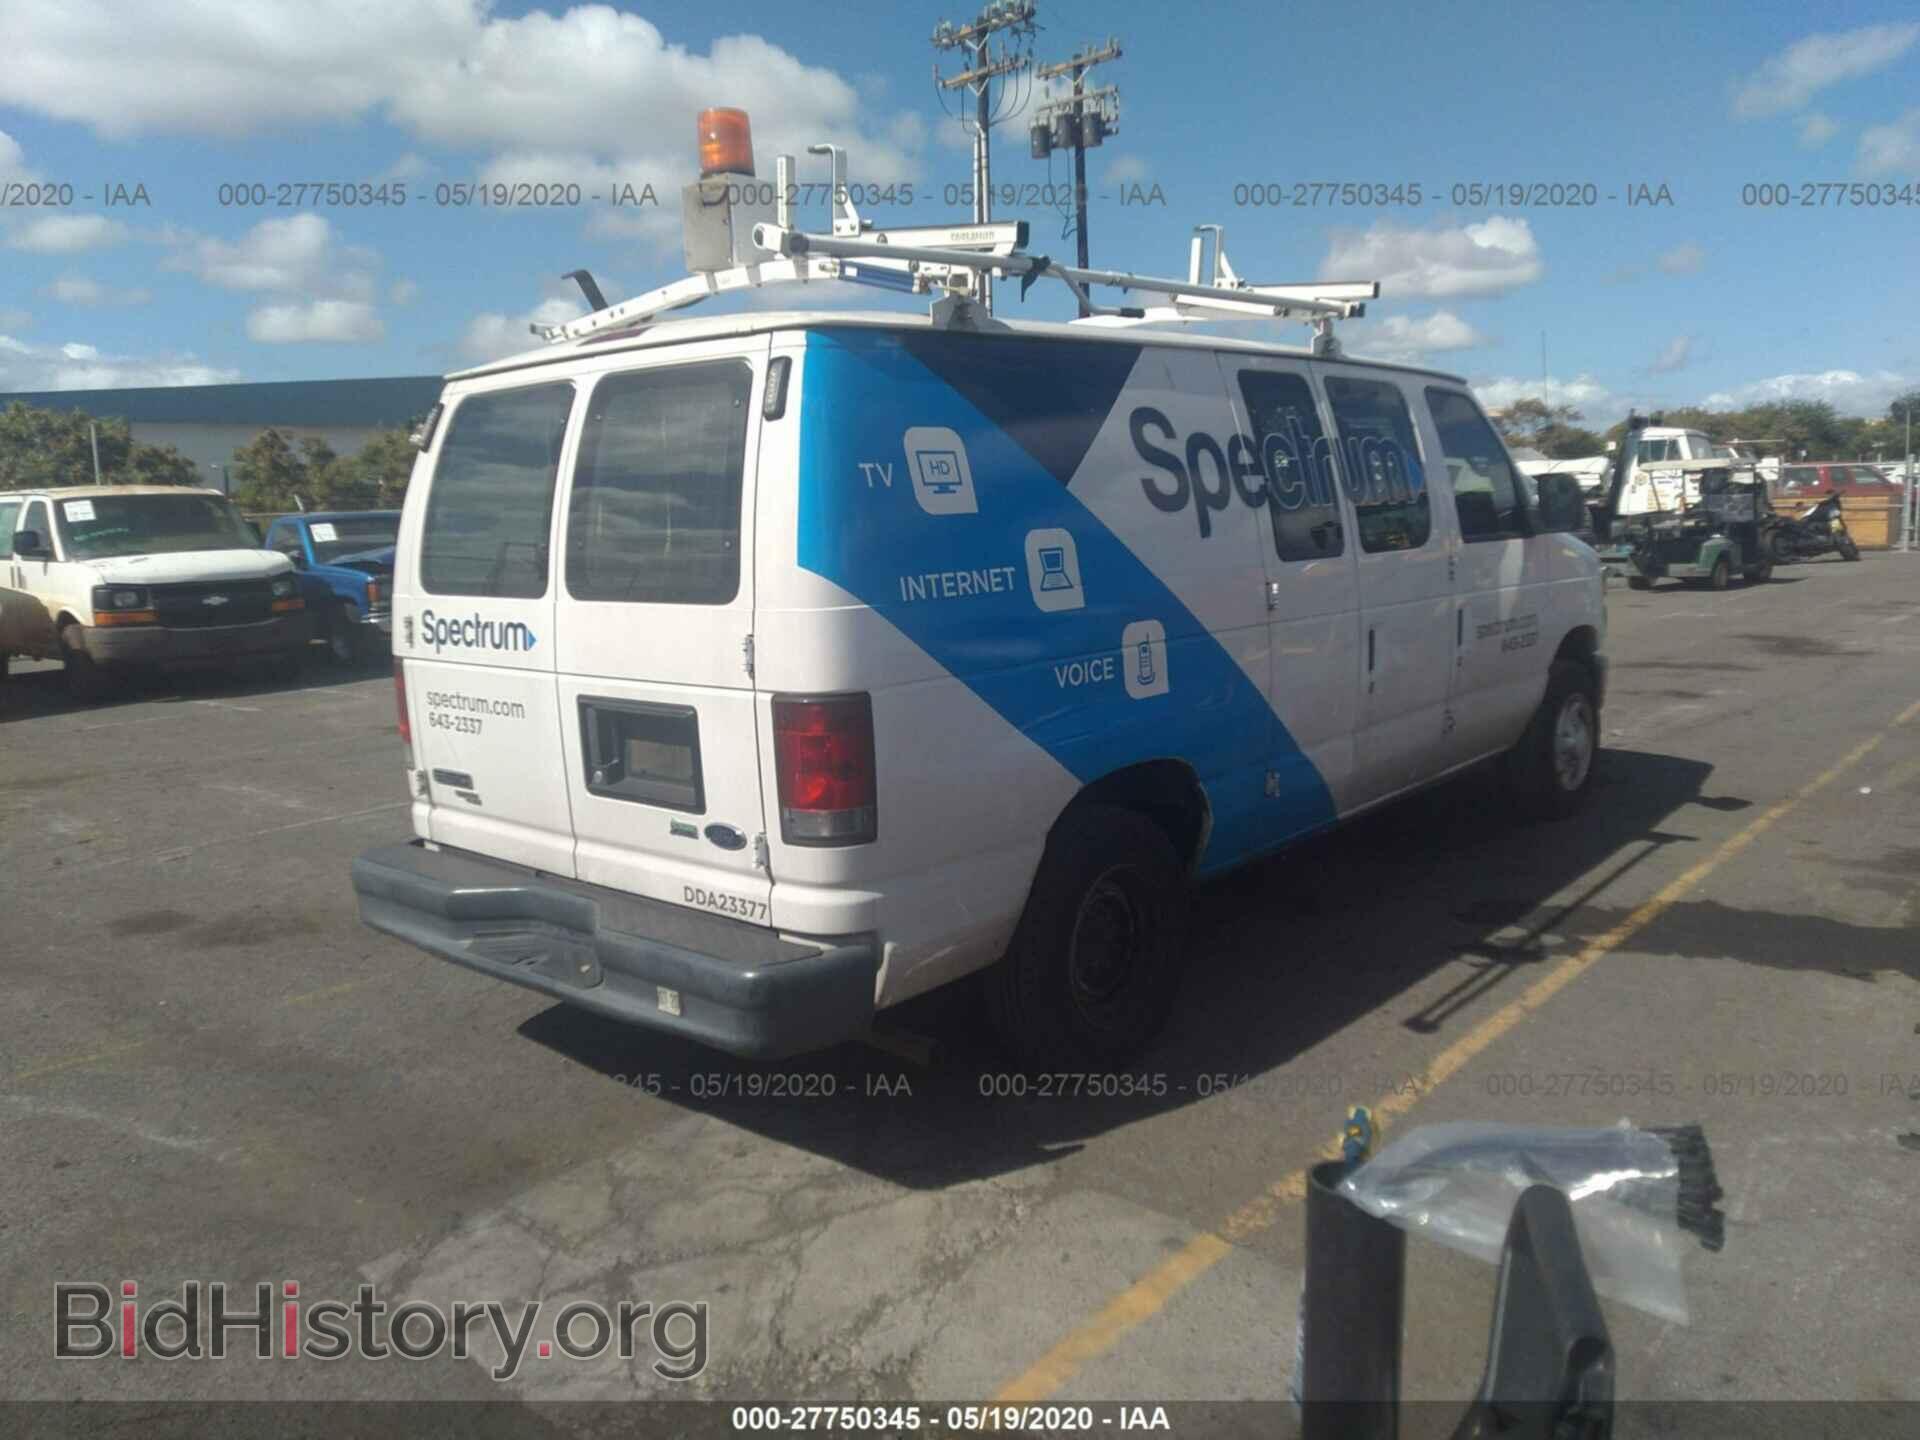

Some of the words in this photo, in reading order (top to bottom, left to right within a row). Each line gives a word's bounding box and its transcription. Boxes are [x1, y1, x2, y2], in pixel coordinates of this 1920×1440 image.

[858, 463, 893, 488] TV
[929, 461, 951, 477] HD
[1129, 406, 1419, 538] Spectrum
[900, 567, 1016, 601] INTERNET
[421, 609, 530, 654] Spectrum
[1054, 658, 1115, 688] VOICE
[426, 690, 526, 719] spectrum.com
[683, 885, 768, 919] DDA23377
